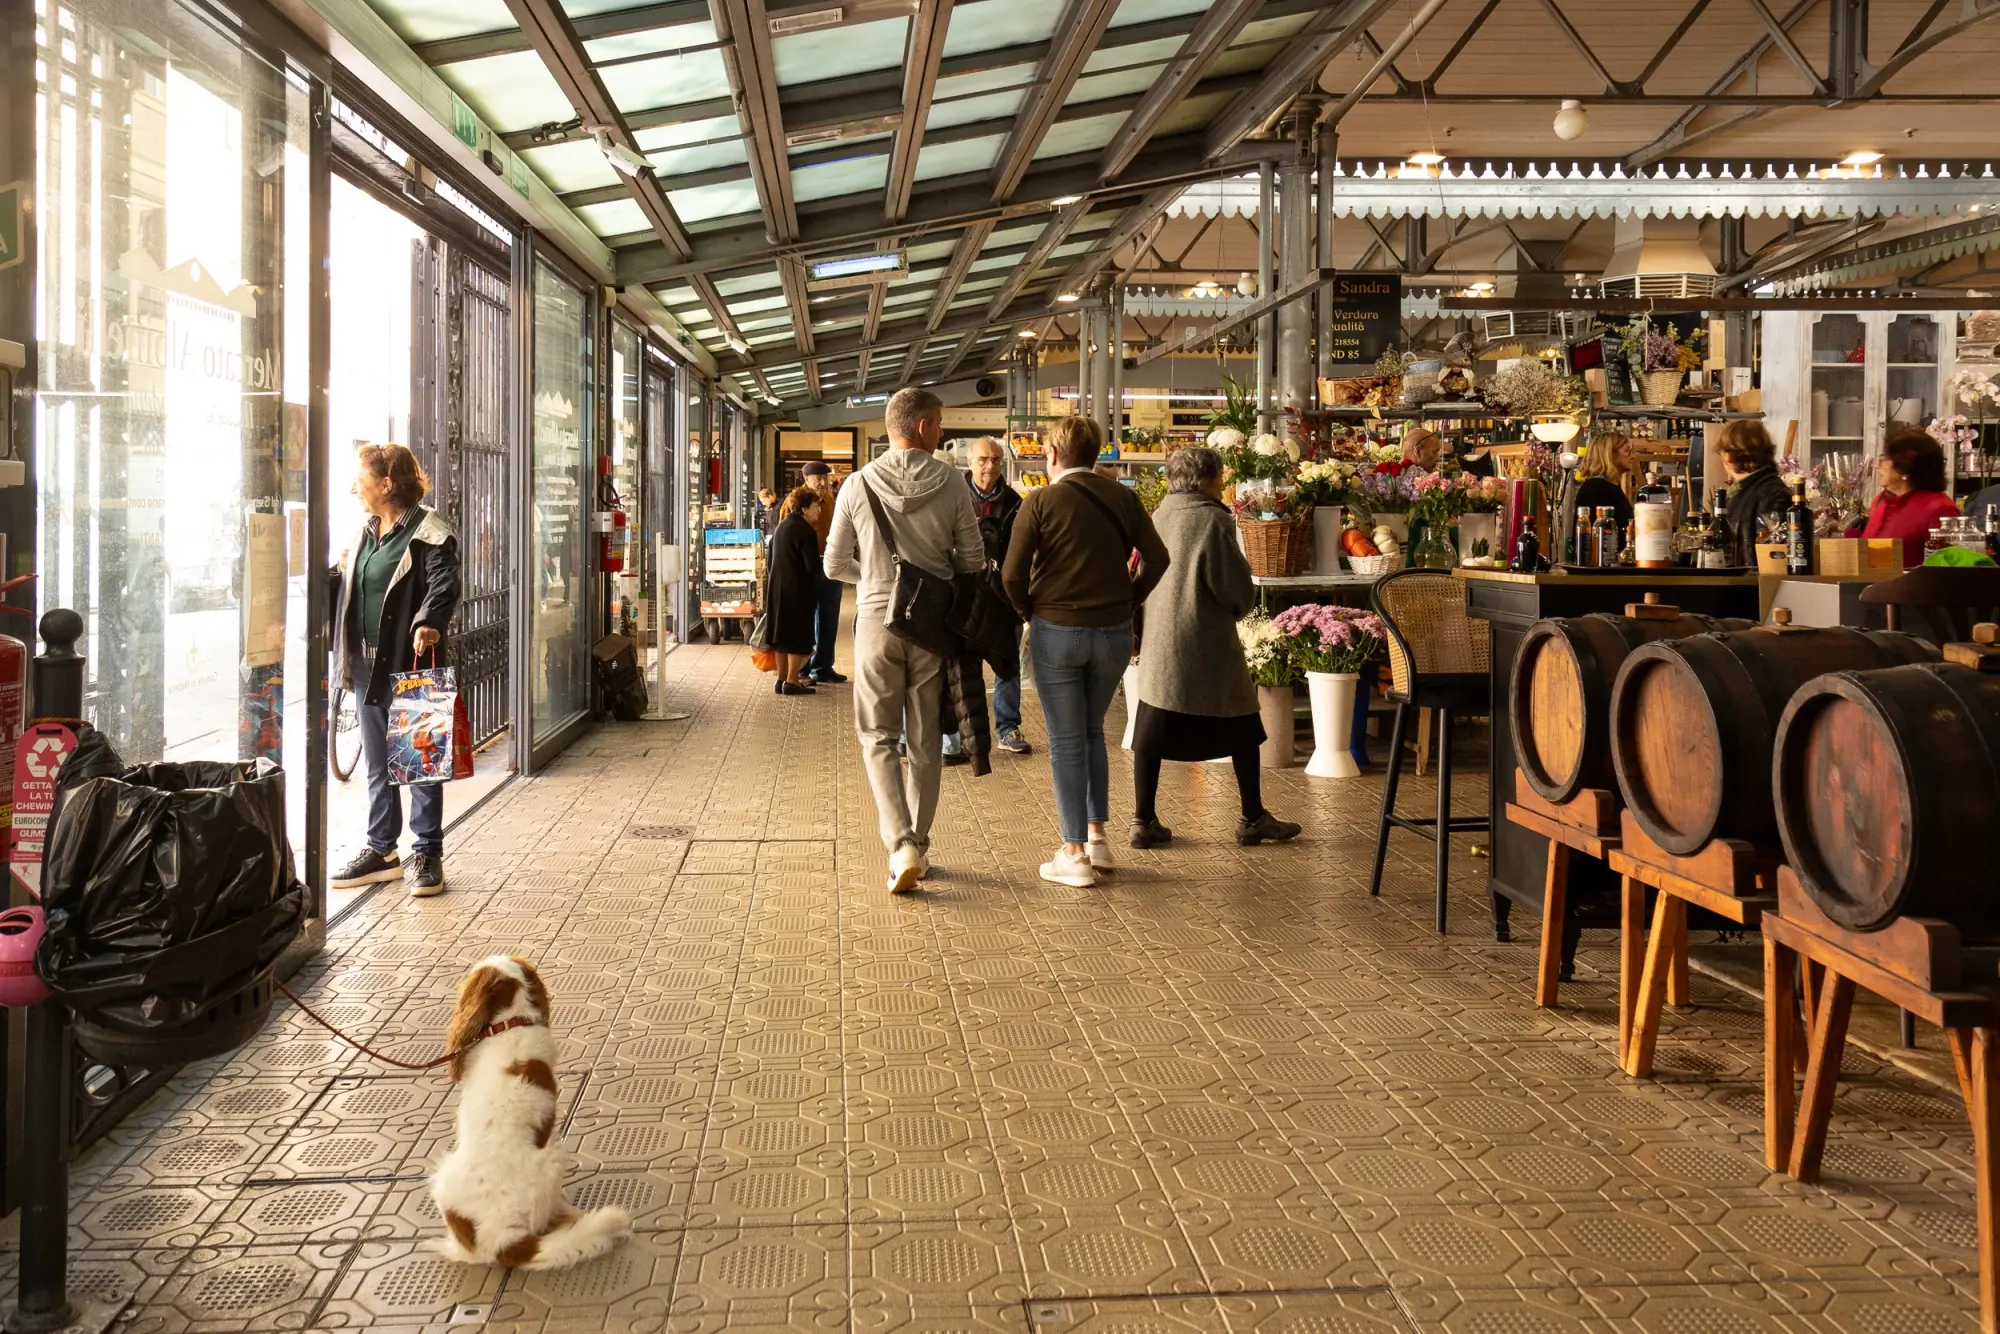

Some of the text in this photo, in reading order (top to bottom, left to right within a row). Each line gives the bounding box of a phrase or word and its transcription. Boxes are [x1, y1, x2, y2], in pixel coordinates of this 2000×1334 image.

[1340, 280, 1390, 294] Sandra
[1334, 309, 1379, 320] Verdura
[1347, 350, 1360, 359] 85
[22, 781, 52, 790] GETTA
[29, 792, 42, 800] LA
